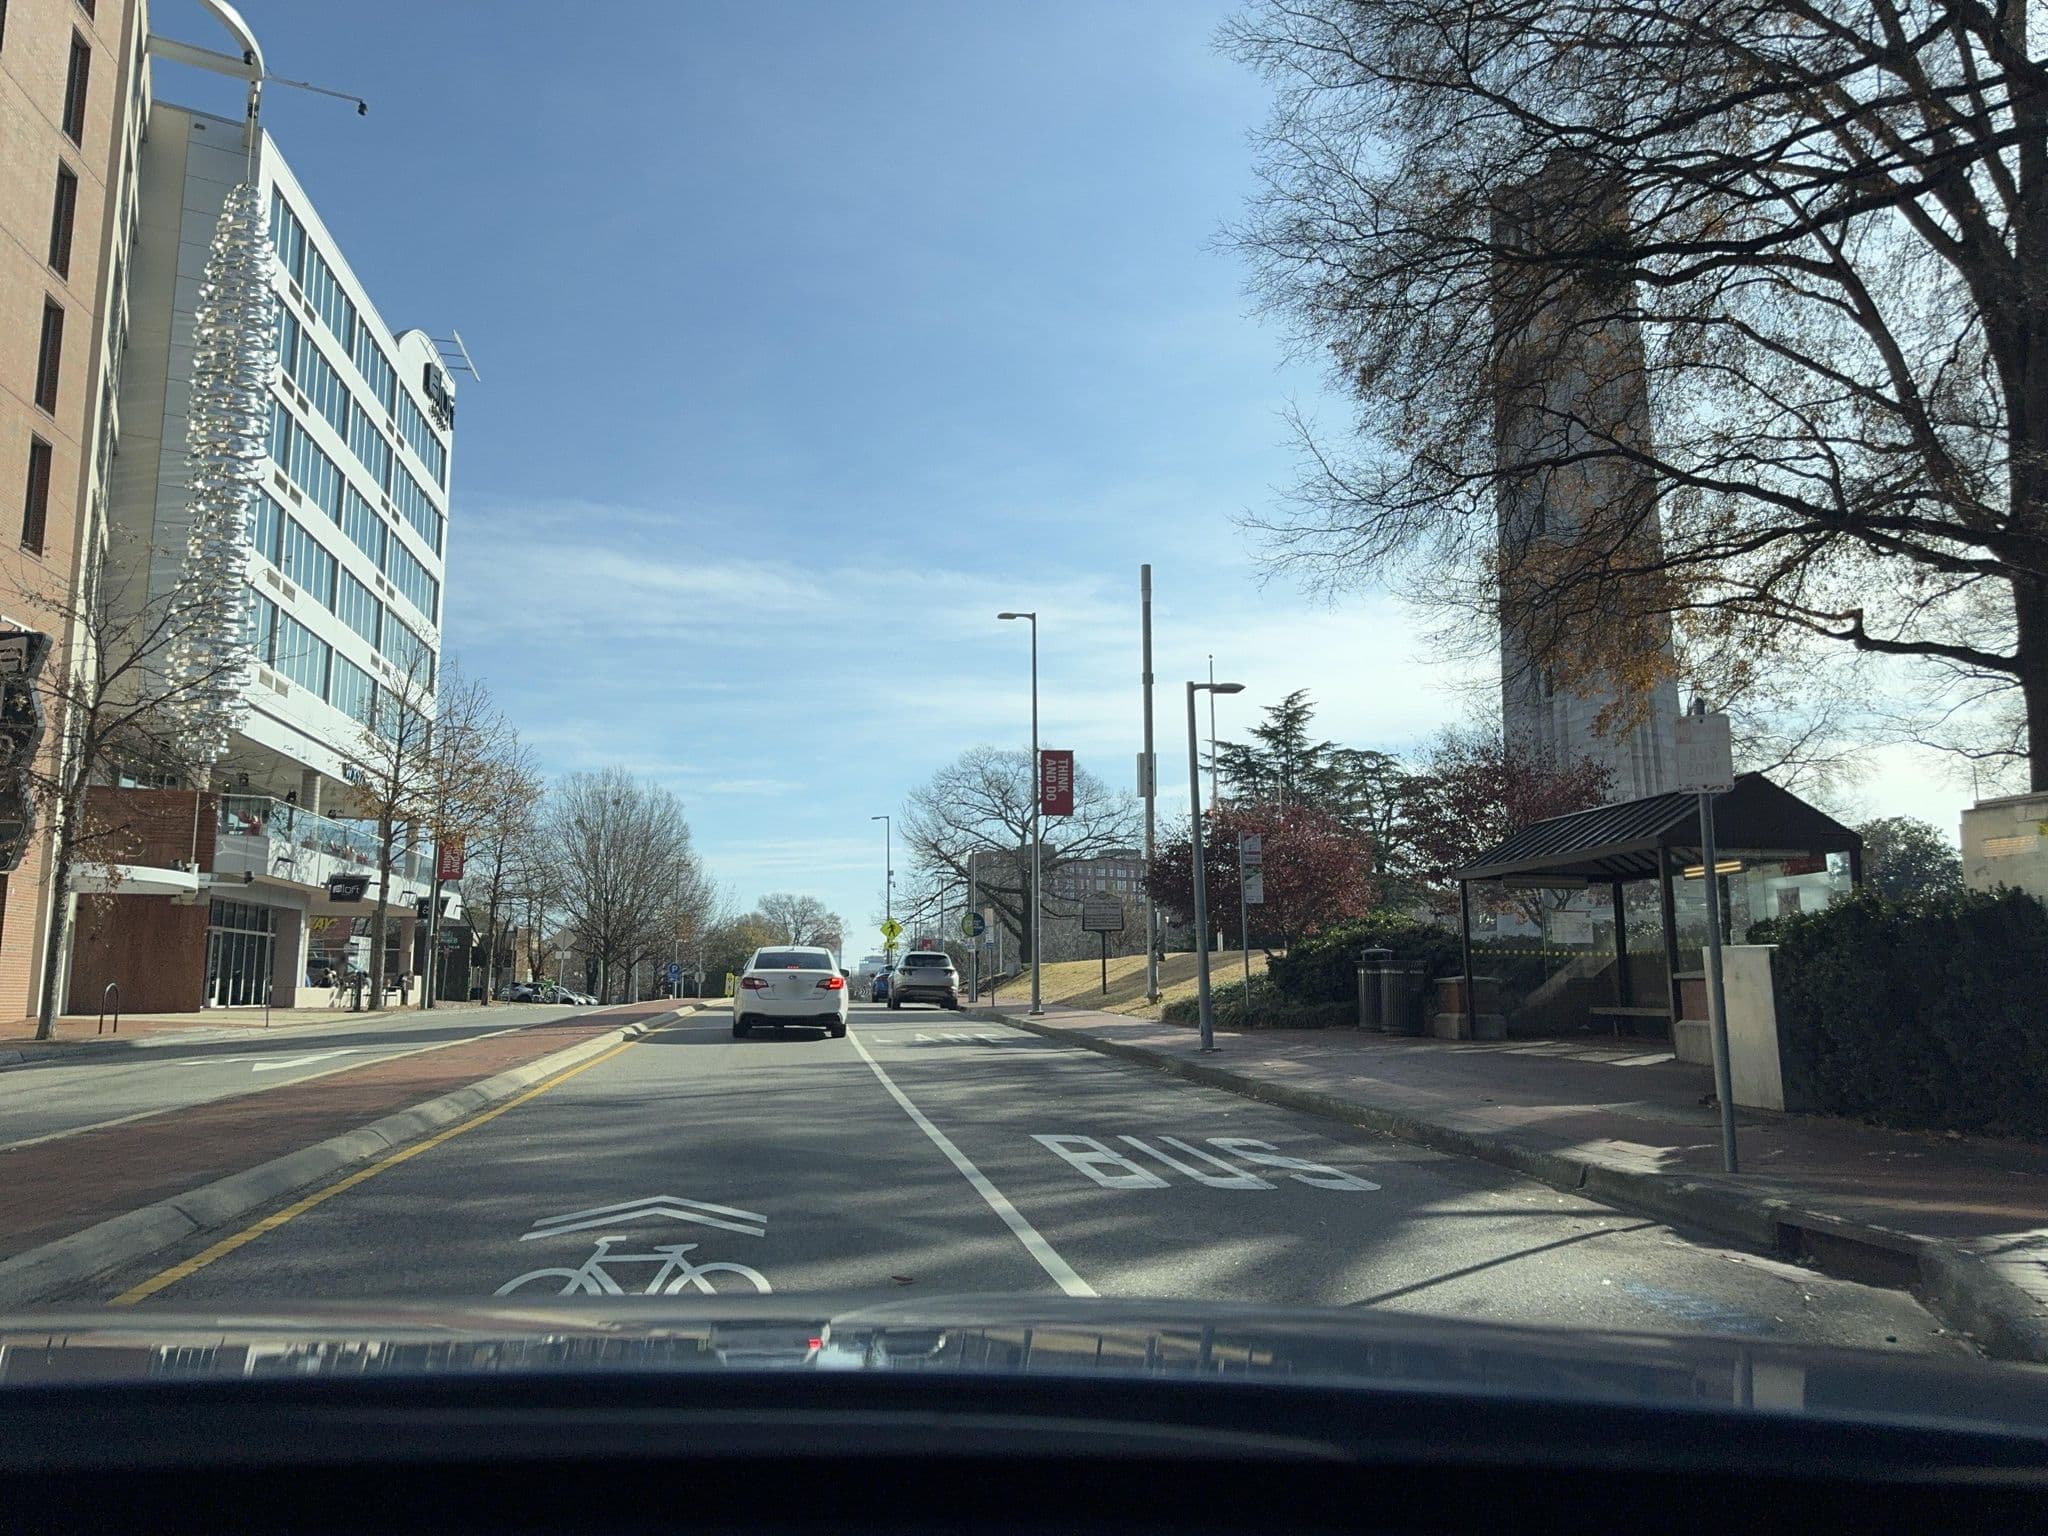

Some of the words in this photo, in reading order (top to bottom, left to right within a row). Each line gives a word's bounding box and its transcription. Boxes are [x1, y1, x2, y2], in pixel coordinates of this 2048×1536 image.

[1046, 758, 1057, 783] AND
[1058, 758, 1069, 793] THINK
[1046, 785, 1057, 801] DO
[1029, 1134, 1382, 1192] BUS
